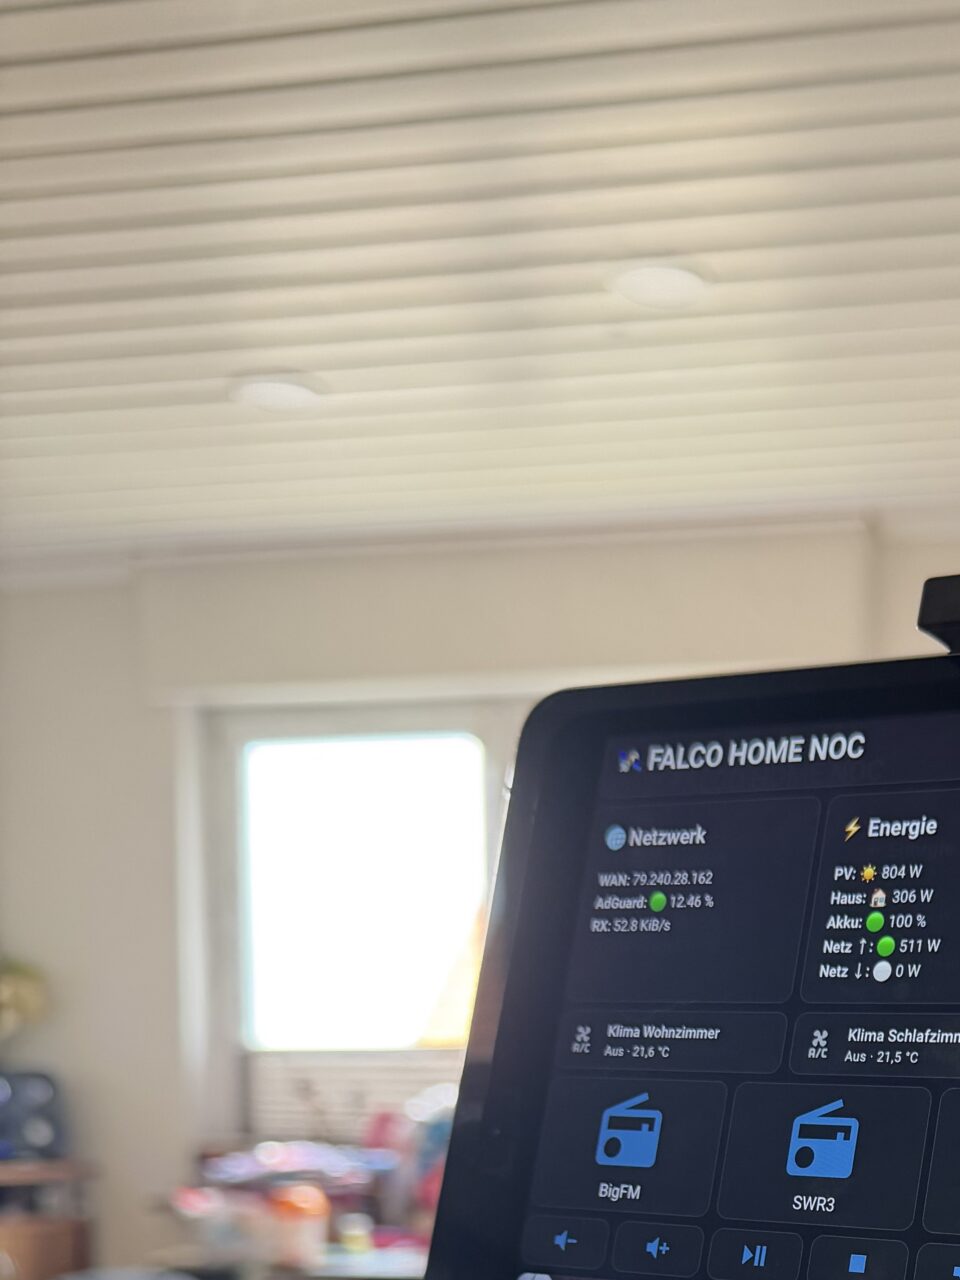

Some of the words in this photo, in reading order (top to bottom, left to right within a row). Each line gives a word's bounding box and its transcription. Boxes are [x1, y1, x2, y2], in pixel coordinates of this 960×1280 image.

[647, 745, 723, 771] FALCO
[728, 737, 803, 766] HOME
[808, 732, 865, 761] NOC
[629, 824, 707, 847] Netzwerk
[867, 815, 938, 840] Energie
[599, 873, 631, 887] WAN:
[632, 869, 713, 886] 79.240.28.162
[834, 866, 856, 881] PV:
[881, 866, 906, 880] 804
[909, 864, 923, 879] W
[595, 894, 648, 909] AdGuard:
[670, 893, 702, 908] 12.46
[704, 894, 714, 908] %
[830, 891, 867, 905] Haus:
[891, 890, 917, 904] 306
[920, 889, 934, 904] W
[591, 919, 612, 932] RX:
[613, 919, 638, 932] 52.8
[640, 918, 671, 932] KiB/s
[826, 915, 863, 930] Akku:
[889, 914, 913, 929] 100
[916, 914, 927, 928] %
[823, 939, 852, 954] Netz
[899, 939, 923, 953] 511
[927, 938, 941, 953] W
[819, 964, 849, 979] Netz
[895, 963, 904, 978] 0
[907, 963, 921, 978] W
[607, 1024, 640, 1038] Klima
[643, 1025, 720, 1040] Wohnzimmer
[848, 1029, 884, 1043] Klima
[604, 1046, 624, 1057] Aus
[632, 1045, 655, 1059] 21,6
[658, 1046, 670, 1058] °C
[844, 1051, 867, 1063] Aus
[877, 1051, 902, 1065] 21,5
[905, 1051, 919, 1064] °C
[598, 1183, 642, 1201] BigFM
[792, 1195, 836, 1213] SWR3
